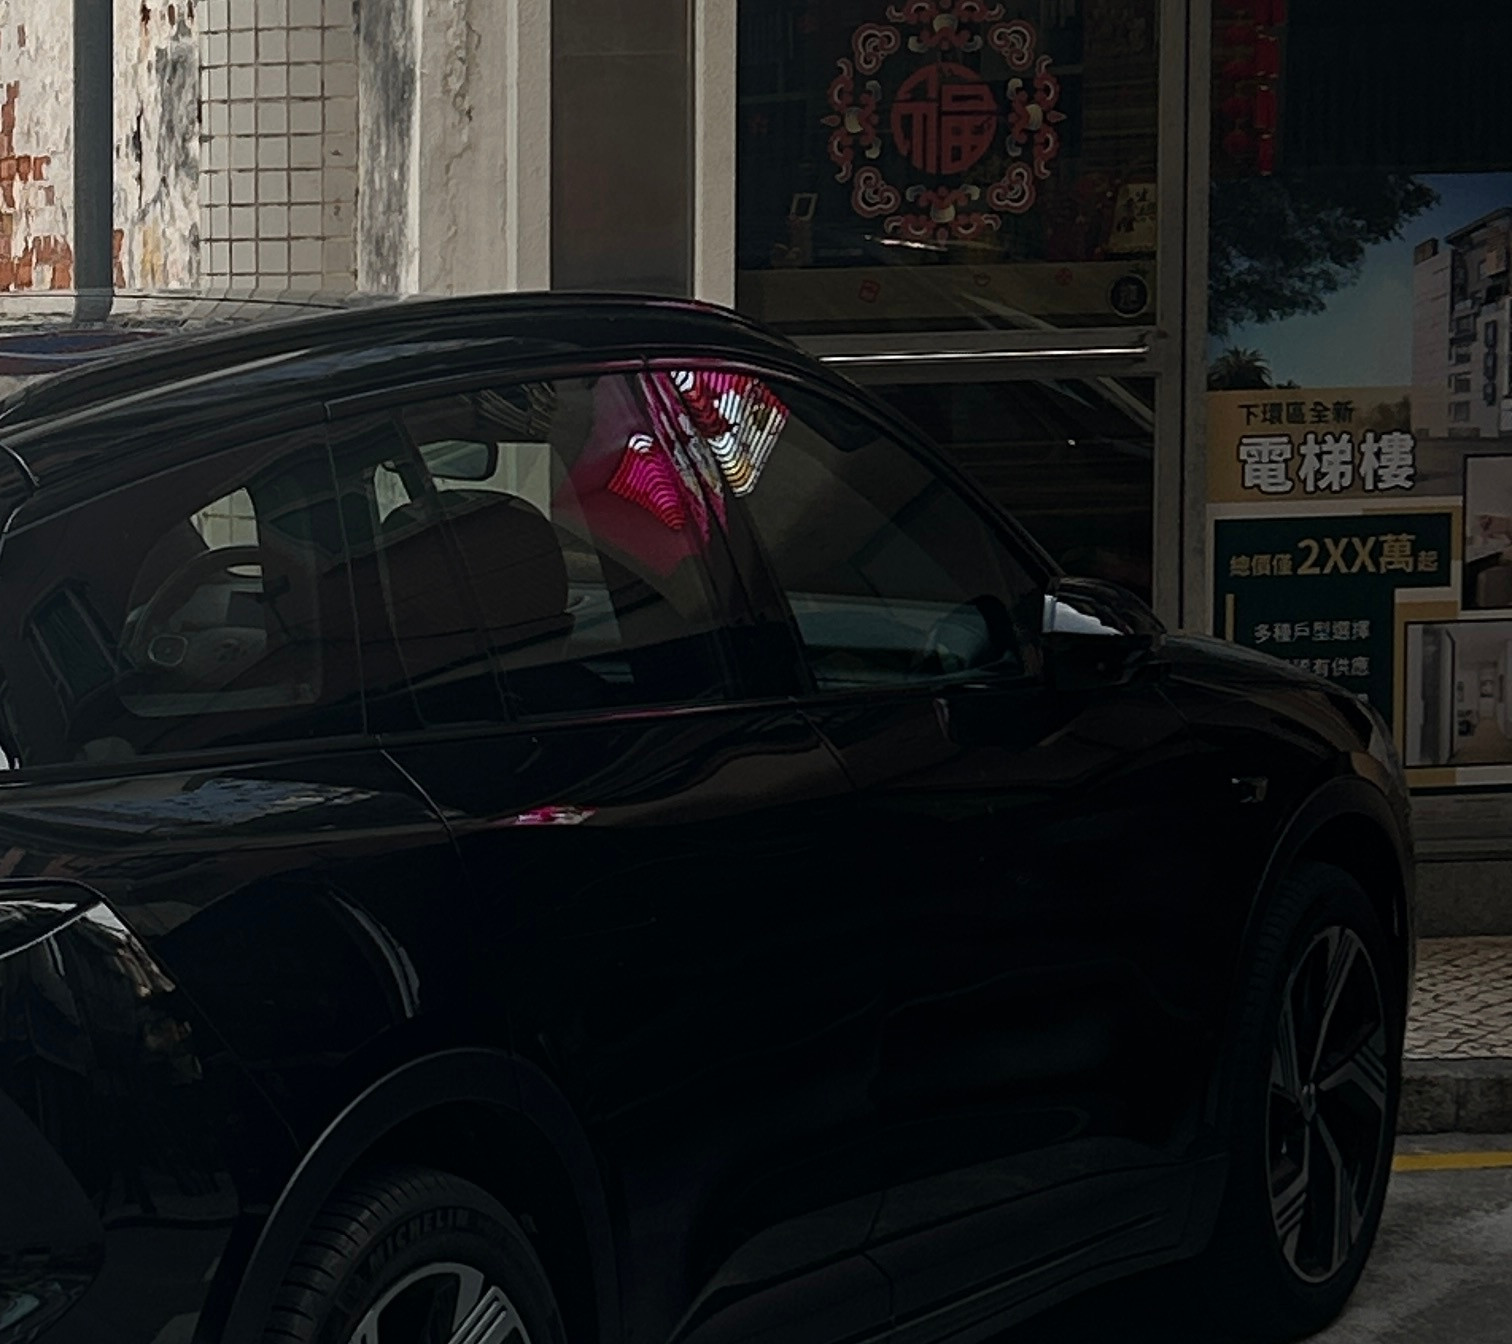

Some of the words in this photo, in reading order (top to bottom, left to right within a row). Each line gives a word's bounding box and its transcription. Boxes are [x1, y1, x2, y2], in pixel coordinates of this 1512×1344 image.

[891, 61, 999, 175] 福
[1237, 399, 1355, 426] 下環區全新
[1238, 430, 1416, 494] 電梯樓
